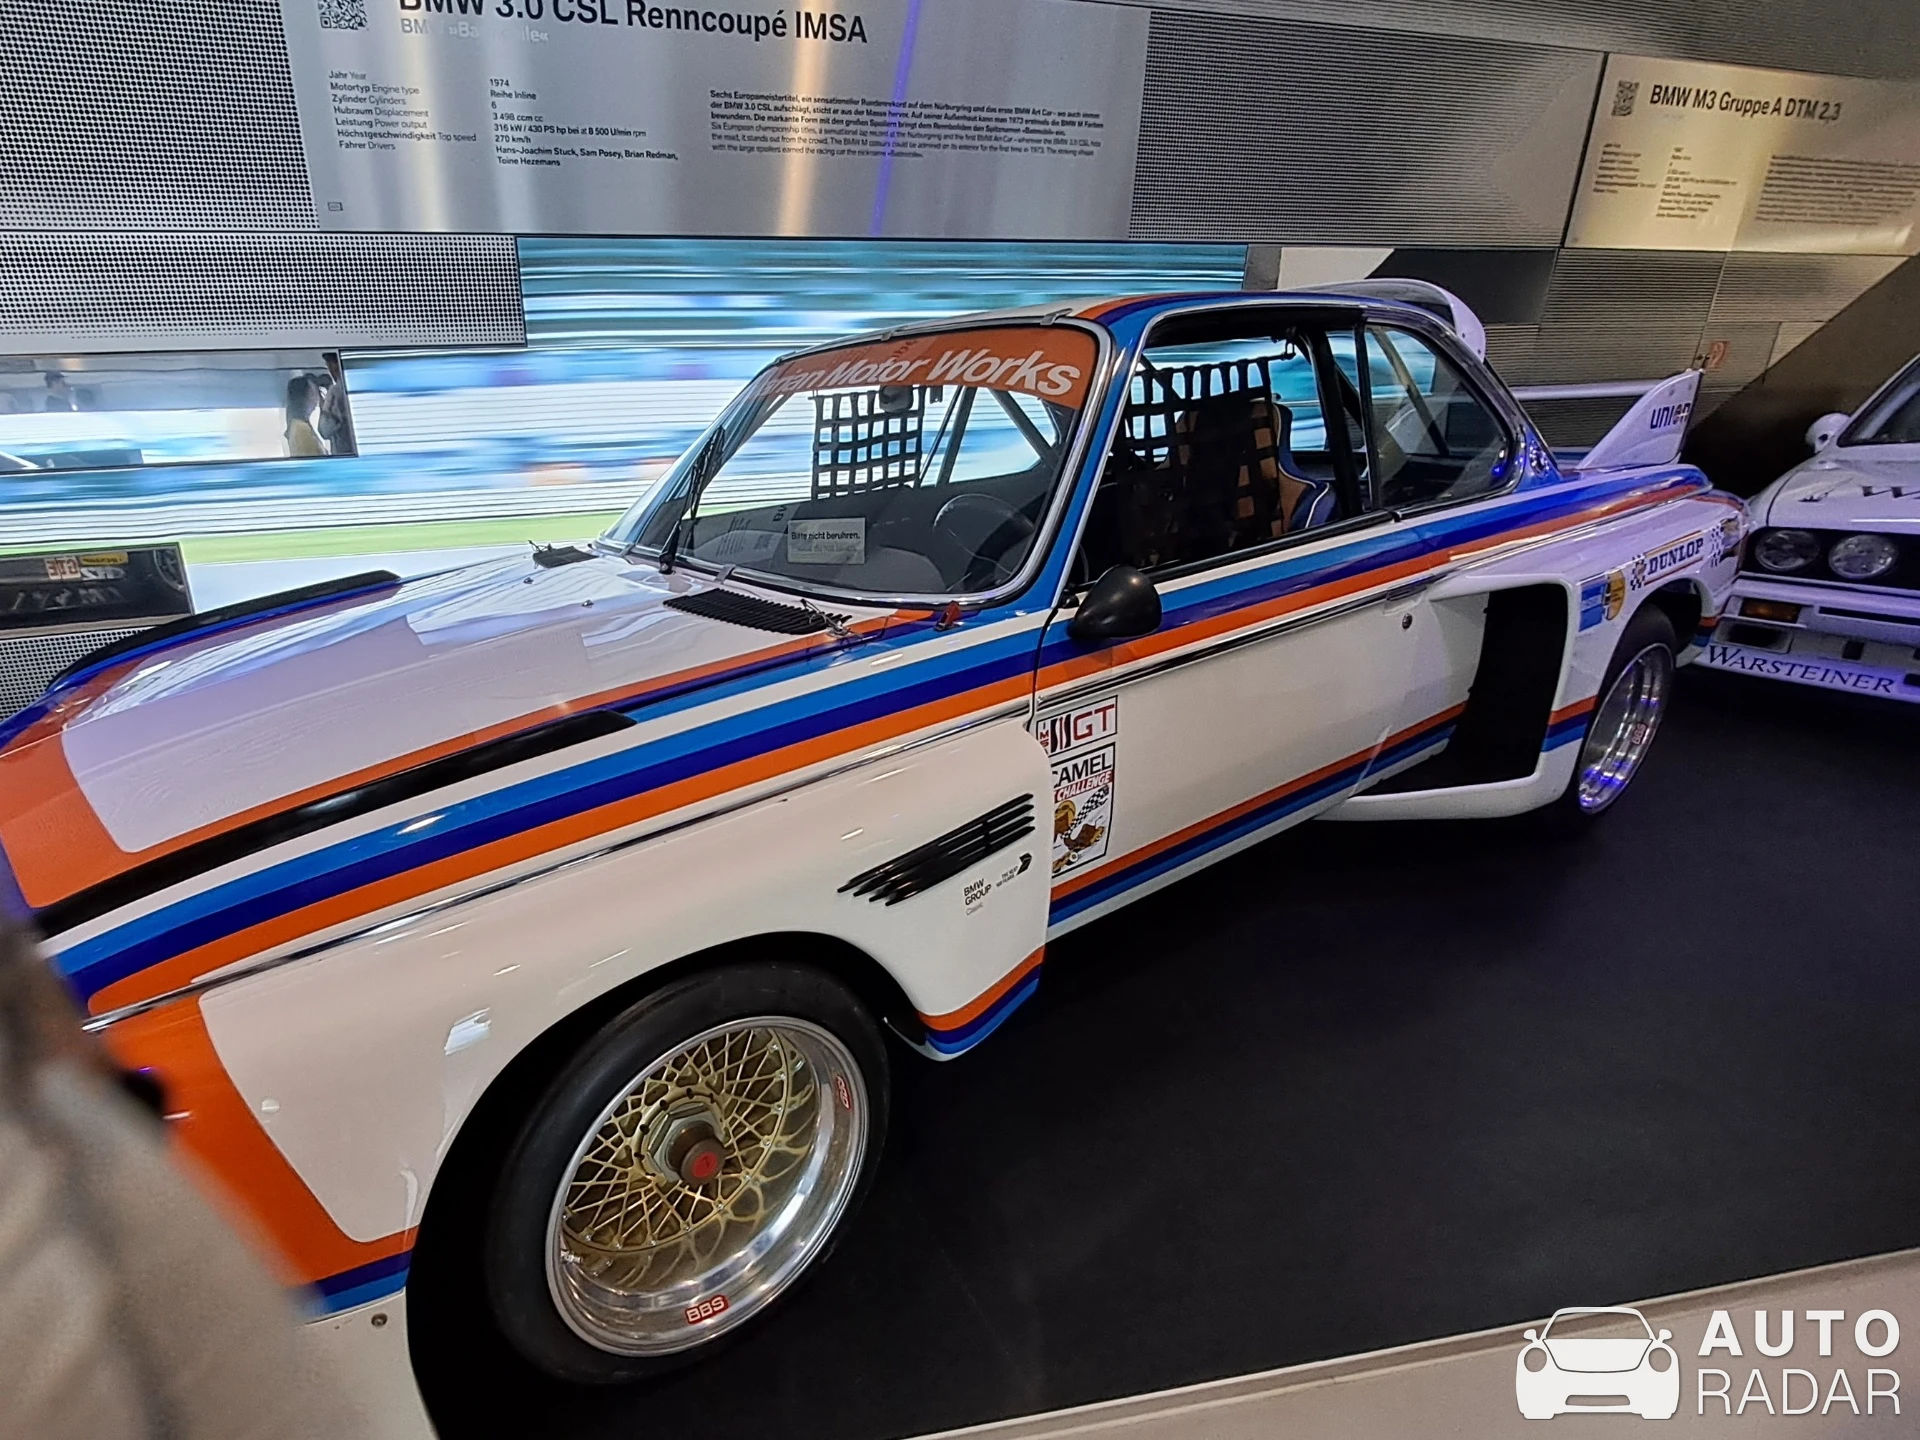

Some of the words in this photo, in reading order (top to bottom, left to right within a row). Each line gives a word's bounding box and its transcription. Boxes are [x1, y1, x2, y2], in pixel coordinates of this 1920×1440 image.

[401, 18, 438, 35] BM
[496, 0, 543, 20] 3.0
[552, 0, 618, 26] CSL
[627, 0, 786, 42] Renncoupé
[795, 10, 867, 43] IMSA
[329, 70, 348, 79] Jahr
[349, 72, 366, 80] Year
[330, 82, 370, 94] Motortyp
[372, 84, 400, 95] Engine
[490, 78, 510, 87] 1974
[332, 94, 366, 105] Zylinder
[369, 96, 406, 106] Cylinders
[490, 90, 513, 99] Reihe
[514, 90, 537, 100] Inline
[1650, 84, 1691, 108] BMW
[1692, 88, 1717, 110] M3
[1719, 92, 1769, 118] Gruppe
[1770, 97, 1781, 116] A
[1785, 98, 1818, 118] DTM
[334, 106, 373, 115] Hubraum
[374, 107, 429, 118] Displacement
[757, 103, 771, 111] CSL
[336, 118, 373, 129] Leistung
[375, 119, 399, 129] Power
[510, 124, 522, 133] kW
[528, 125, 542, 133] 430
[544, 125, 555, 134] PS
[556, 126, 566, 135] hp
[338, 128, 436, 142] Höchstgeschwindigkeit
[453, 132, 477, 143] speed
[495, 134, 510, 143] 270
[340, 140, 366, 150] Fahrer
[368, 142, 396, 151] Drivers
[496, 146, 552, 156] Hans-Joachim
[554, 147, 579, 157] Stuck,
[580, 148, 597, 157] Sam
[598, 149, 623, 159] Posey,
[624, 150, 645, 158] Brian
[646, 150, 678, 160] Redman,
[498, 156, 519, 165] Toine
[520, 157, 561, 166] Hezemans
[819, 357, 930, 386] Motor
[927, 348, 1081, 397] Works
[1647, 537, 1704, 576] DUNLOP
[1709, 644, 1894, 693] WARSTEINER
[1073, 703, 1115, 741] GT
[1057, 769, 1112, 801] CHALLENGE
[964, 878, 985, 897] BMW
[965, 884, 992, 906] GROUP
[686, 1296, 725, 1322] BBS
